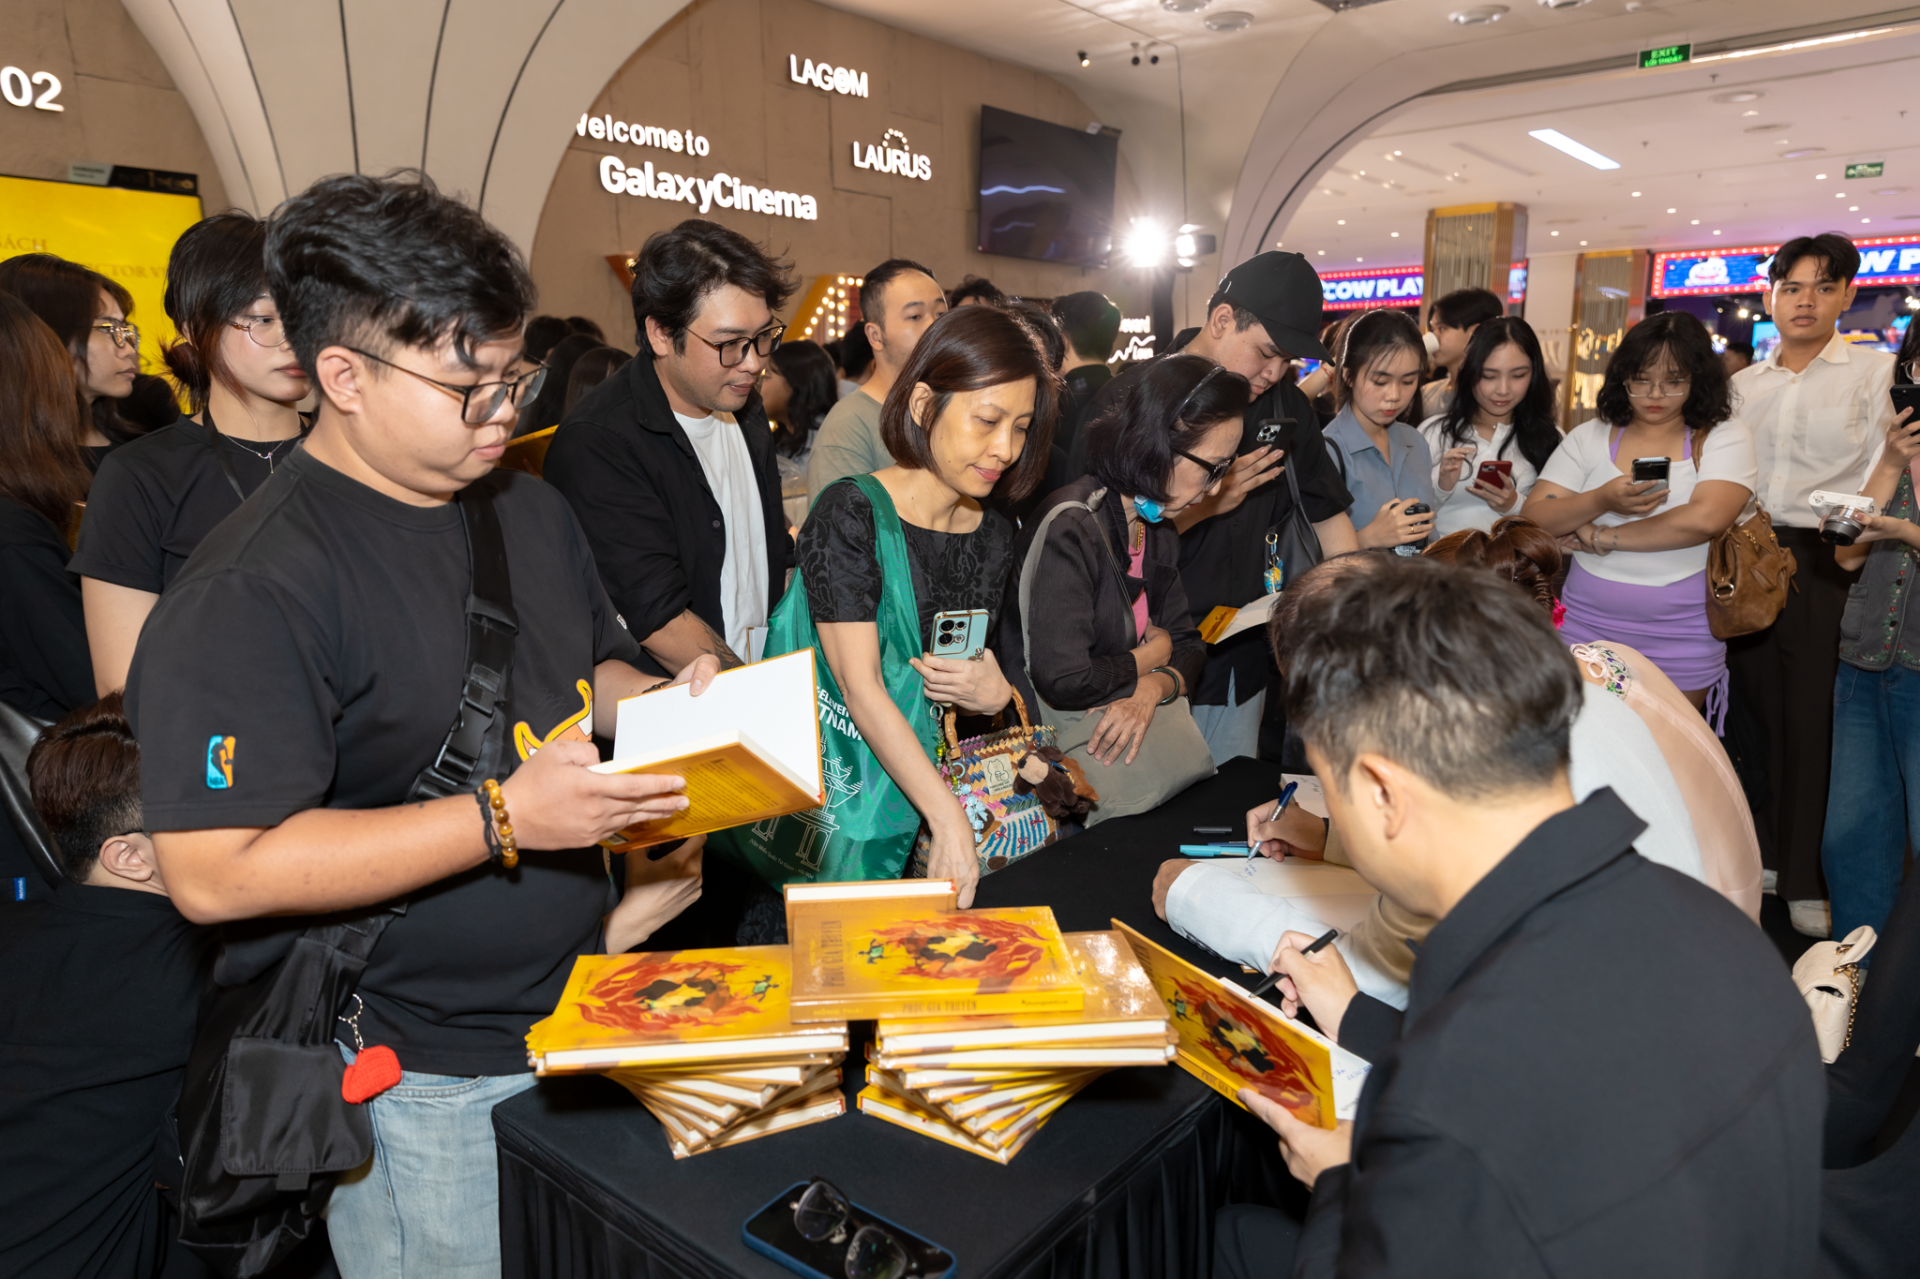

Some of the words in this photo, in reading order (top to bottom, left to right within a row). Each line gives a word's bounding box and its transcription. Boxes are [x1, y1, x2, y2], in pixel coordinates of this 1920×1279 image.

[1651, 46, 1679, 59] EXIT
[0, 66, 65, 112] 02
[790, 53, 868, 98] LAGOM
[685, 129, 710, 156] to
[853, 140, 932, 181] LAURUS
[0, 233, 47, 251] ÁCH
[817, 701, 862, 741] TNAM
